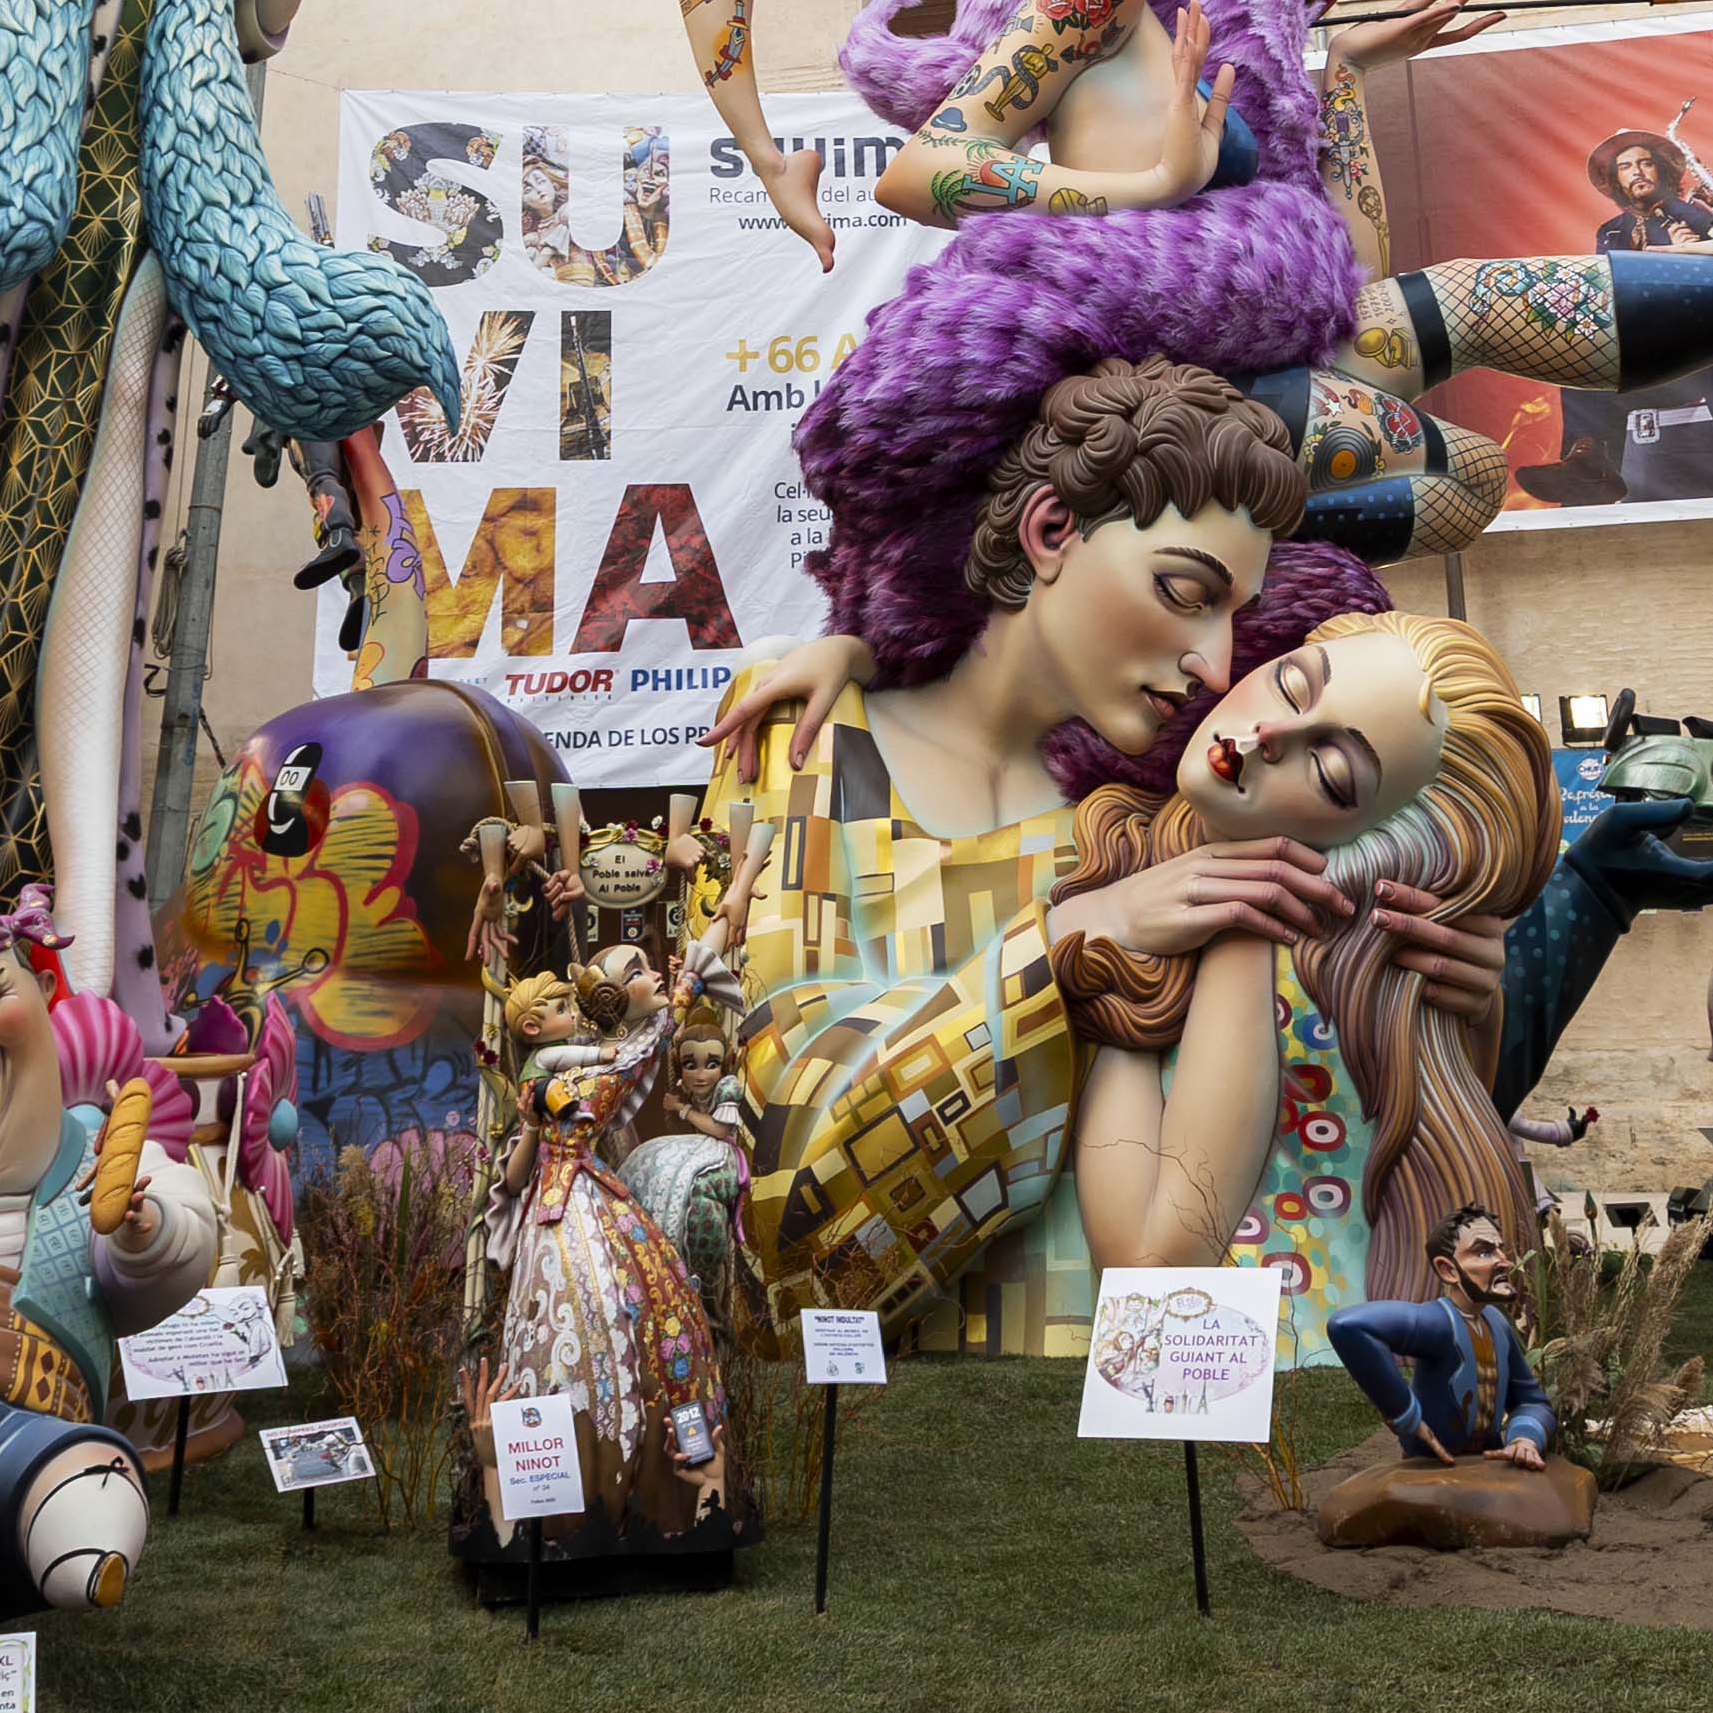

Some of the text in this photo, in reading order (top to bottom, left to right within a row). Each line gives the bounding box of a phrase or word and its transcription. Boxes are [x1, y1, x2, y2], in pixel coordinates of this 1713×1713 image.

[822, 186, 850, 203] del
[726, 382, 804, 412] Amb
[777, 505, 833, 523] la seu
[791, 528, 823, 545] a la
[505, 669, 614, 696] TUDOR
[631, 667, 731, 692] PHILIP
[608, 729, 635, 747] DE
[641, 727, 680, 746] LOS
[1203, 1319, 1220, 1330] LA
[1165, 1335, 1258, 1346] SOLIDARITAT
[1170, 1351, 1247, 1363] GUIANT AL
[1183, 1368, 1230, 1380] POBLE
[677, 1405, 701, 1424] 2012
[508, 1437, 563, 1454] MILLOR
[515, 1455, 561, 1471] NINOT
[509, 1471, 571, 1486] Sec. ESPECIAL
[1, 1690, 15, 1698] en
